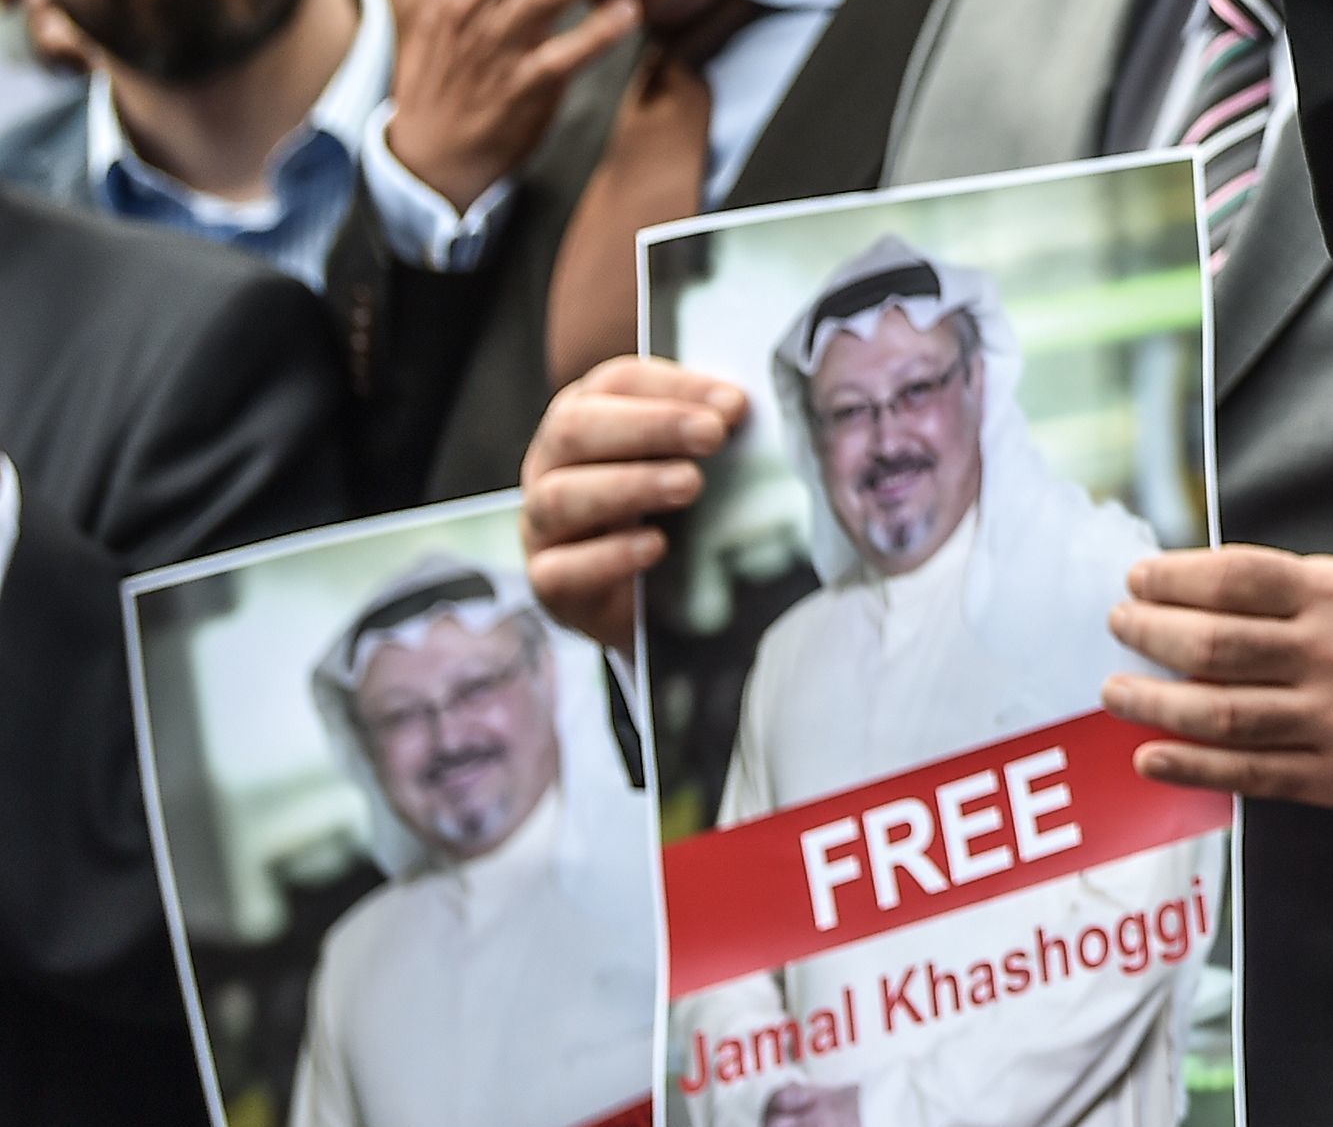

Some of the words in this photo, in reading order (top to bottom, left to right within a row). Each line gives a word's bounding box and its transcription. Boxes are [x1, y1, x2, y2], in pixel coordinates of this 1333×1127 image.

[800, 746, 1081, 931] FREE
[680, 987, 857, 1095] Jamal
[880, 877, 1208, 1033] Khashoggi
